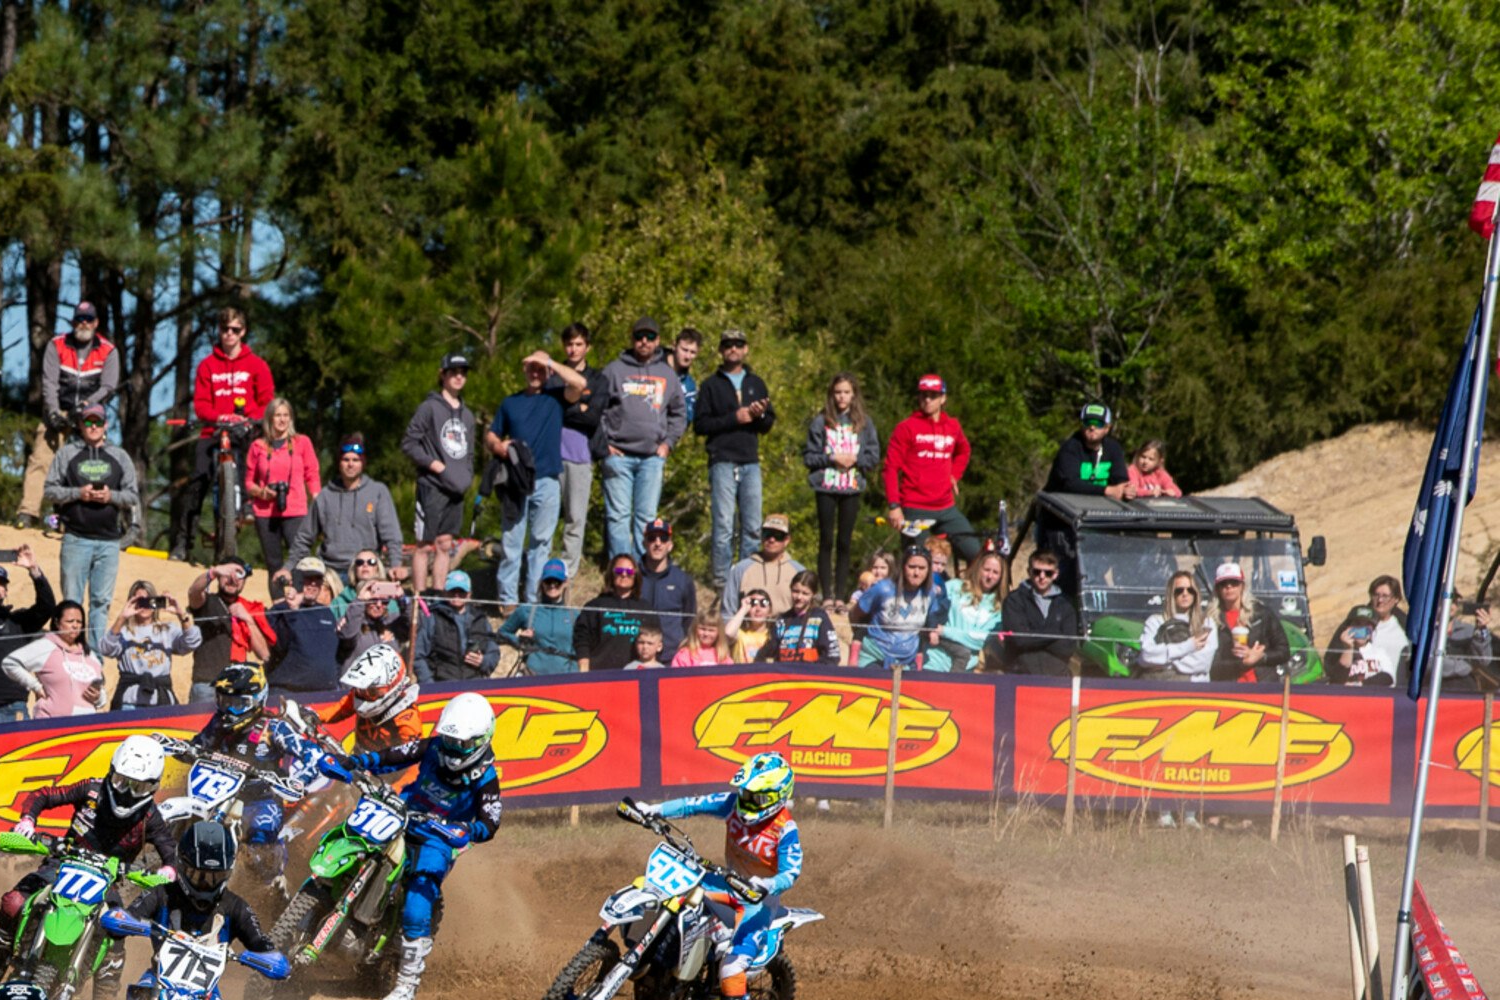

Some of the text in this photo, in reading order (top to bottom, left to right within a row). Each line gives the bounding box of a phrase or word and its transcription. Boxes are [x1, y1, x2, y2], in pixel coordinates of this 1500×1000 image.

[697, 694, 952, 749] FMF
[1052, 710, 1345, 766] FMF
[791, 751, 852, 768] RACING
[1164, 767, 1231, 782] RACING
[191, 767, 240, 801] 713
[348, 800, 402, 842] 310
[648, 851, 699, 895] 505
[313, 912, 339, 950] KENDA
[162, 946, 223, 989] 715
